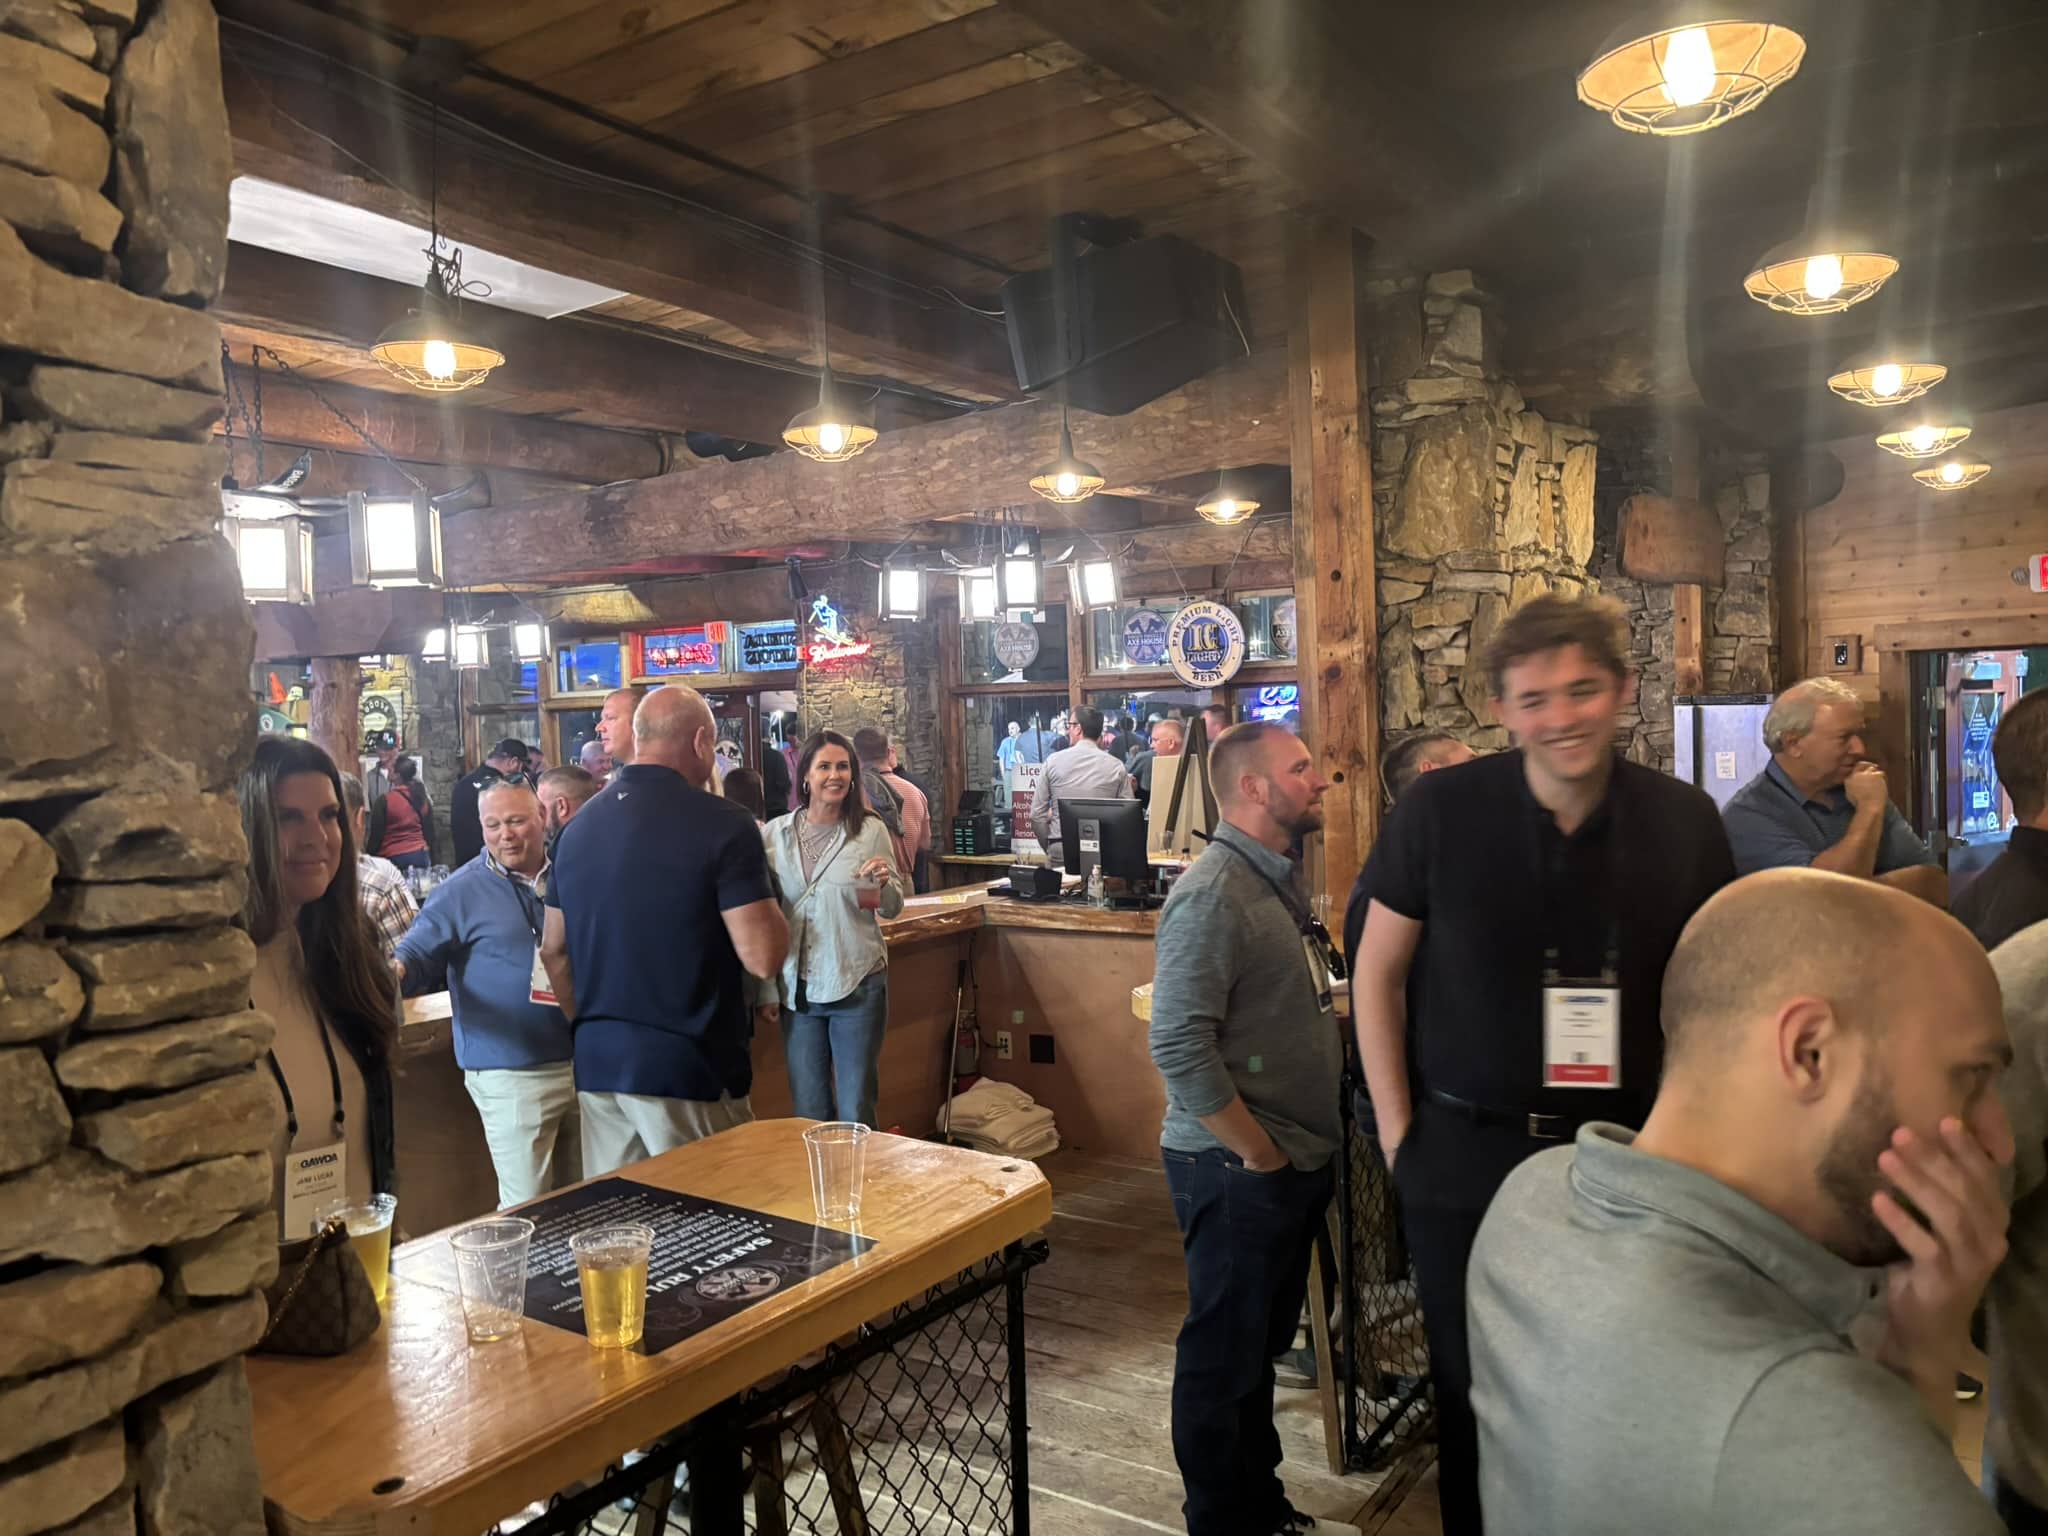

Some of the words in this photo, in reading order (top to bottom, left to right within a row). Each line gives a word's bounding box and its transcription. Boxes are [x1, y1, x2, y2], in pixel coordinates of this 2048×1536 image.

[1172, 605, 1212, 647] PREMIUM
[1215, 608, 1239, 645] LIGHT
[1192, 671, 1223, 682] BEER
[1020, 766, 1041, 776] Lice
[1012, 802, 1032, 810] Alcoh
[692, 1236, 773, 1275] SAFETY
[646, 1272, 694, 1297] RUL
